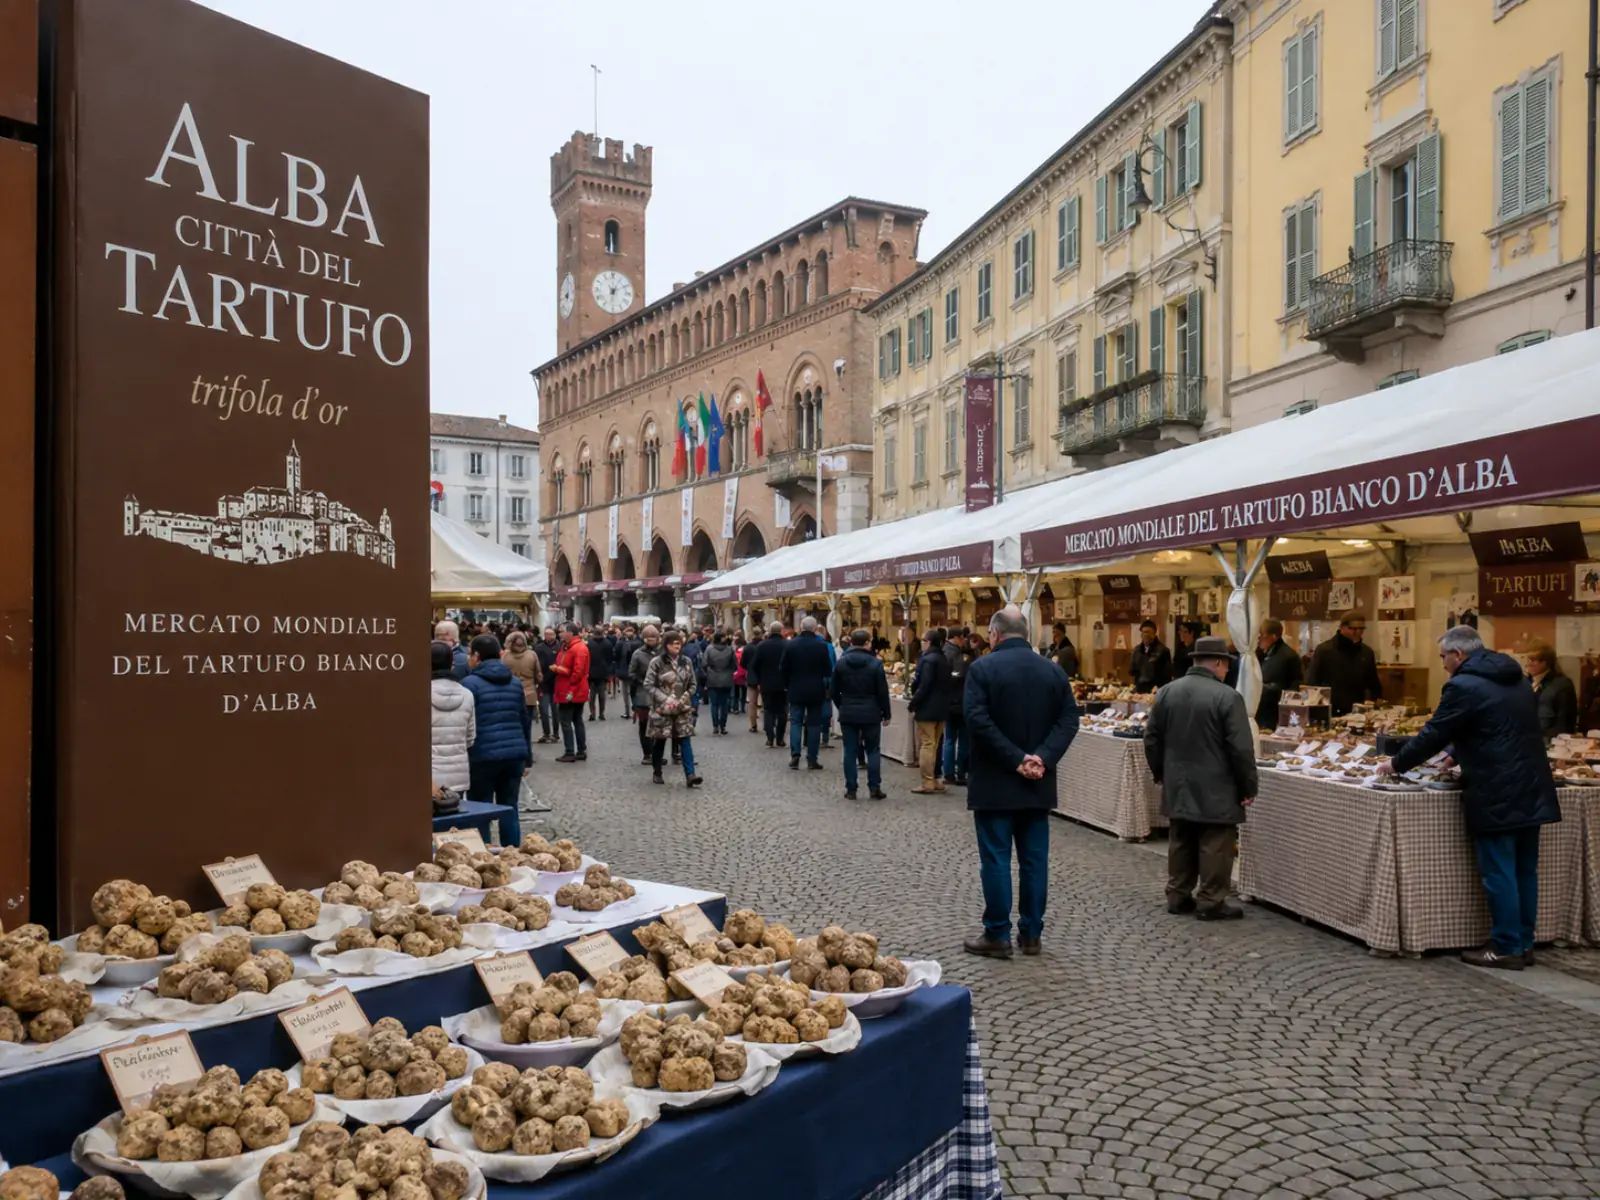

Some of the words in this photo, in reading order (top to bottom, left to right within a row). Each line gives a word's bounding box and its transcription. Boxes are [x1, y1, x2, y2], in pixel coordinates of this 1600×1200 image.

[145, 101, 385, 247] ALBA
[175, 215, 285, 269] CITTÀ
[298, 245, 362, 288] DEL
[105, 242, 413, 366] TARTUFO
[191, 373, 284, 421] trifola
[291, 386, 349, 425] d'or
[1065, 526, 1115, 554] MERCATO
[1117, 514, 1185, 546] MONDIALE
[1188, 508, 1219, 535] DEL
[1221, 493, 1306, 529] TARTUFO
[1311, 475, 1401, 517] BIANCO
[1407, 454, 1518, 502] D'ALBA
[124, 613, 261, 634] MERCATO
[273, 616, 397, 636] MONDIALE
[113, 655, 170, 675] DEL
[183, 654, 306, 674] TARTUFO
[318, 653, 405, 672] BIANCO
[223, 692, 317, 713] D'ALBA
